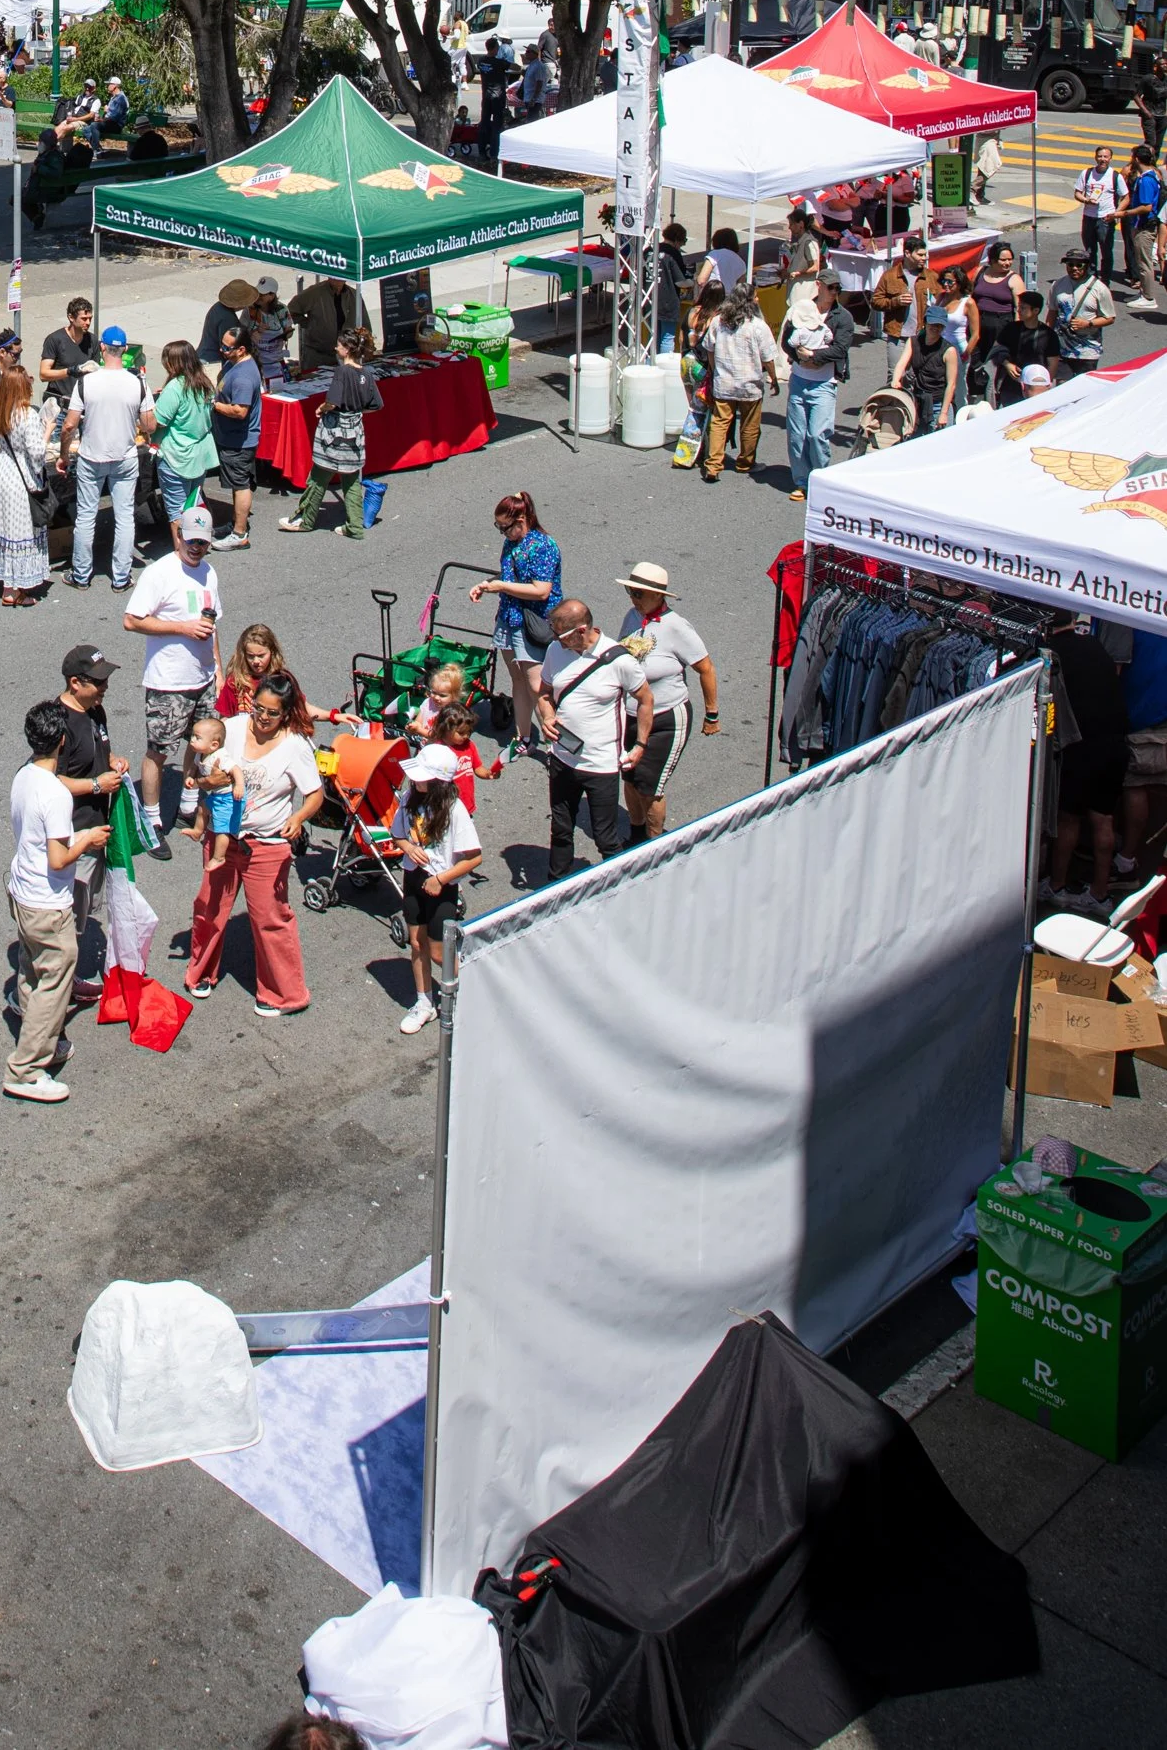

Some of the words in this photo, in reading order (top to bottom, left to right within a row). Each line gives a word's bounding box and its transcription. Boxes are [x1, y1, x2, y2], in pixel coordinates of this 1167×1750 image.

[623, 38, 634, 189] START
[916, 120, 955, 137] Francisco
[956, 115, 981, 129] Italian
[982, 109, 1012, 124] Athletic
[1013, 106, 1032, 120] Club
[252, 171, 282, 184] SFIAC
[106, 204, 130, 223] San
[132, 210, 197, 238] Francisco
[198, 223, 244, 248] Italian
[248, 234, 308, 262] Athletic
[310, 248, 347, 271] Club
[368, 252, 387, 270] San
[389, 244, 435, 264] Francisco
[436, 236, 468, 254] Italian
[469, 226, 507, 246] Athletic
[508, 220, 528, 236] Club
[530, 209, 580, 231] Foundation
[450, 338, 474, 349] MPOST
[476, 336, 508, 349] COMPOST
[1099, 502, 1167, 523] FOUNDATIO
[824, 506, 862, 536] San
[868, 518, 978, 565] Francisco
[982, 547, 1062, 589] Italian
[1066, 1010, 1090, 1028] tees
[986, 1200, 1026, 1224] SOILED
[1029, 1218, 1065, 1242] PAPER
[1077, 1240, 1112, 1262] FOOD
[985, 1268, 1112, 1340] COMPOST
[1011, 1300, 1034, 1320] 堆肥
[1124, 1284, 1167, 1340] COMPO
[1042, 1315, 1084, 1342] Abono
[1022, 1377, 1066, 1406] Recology
